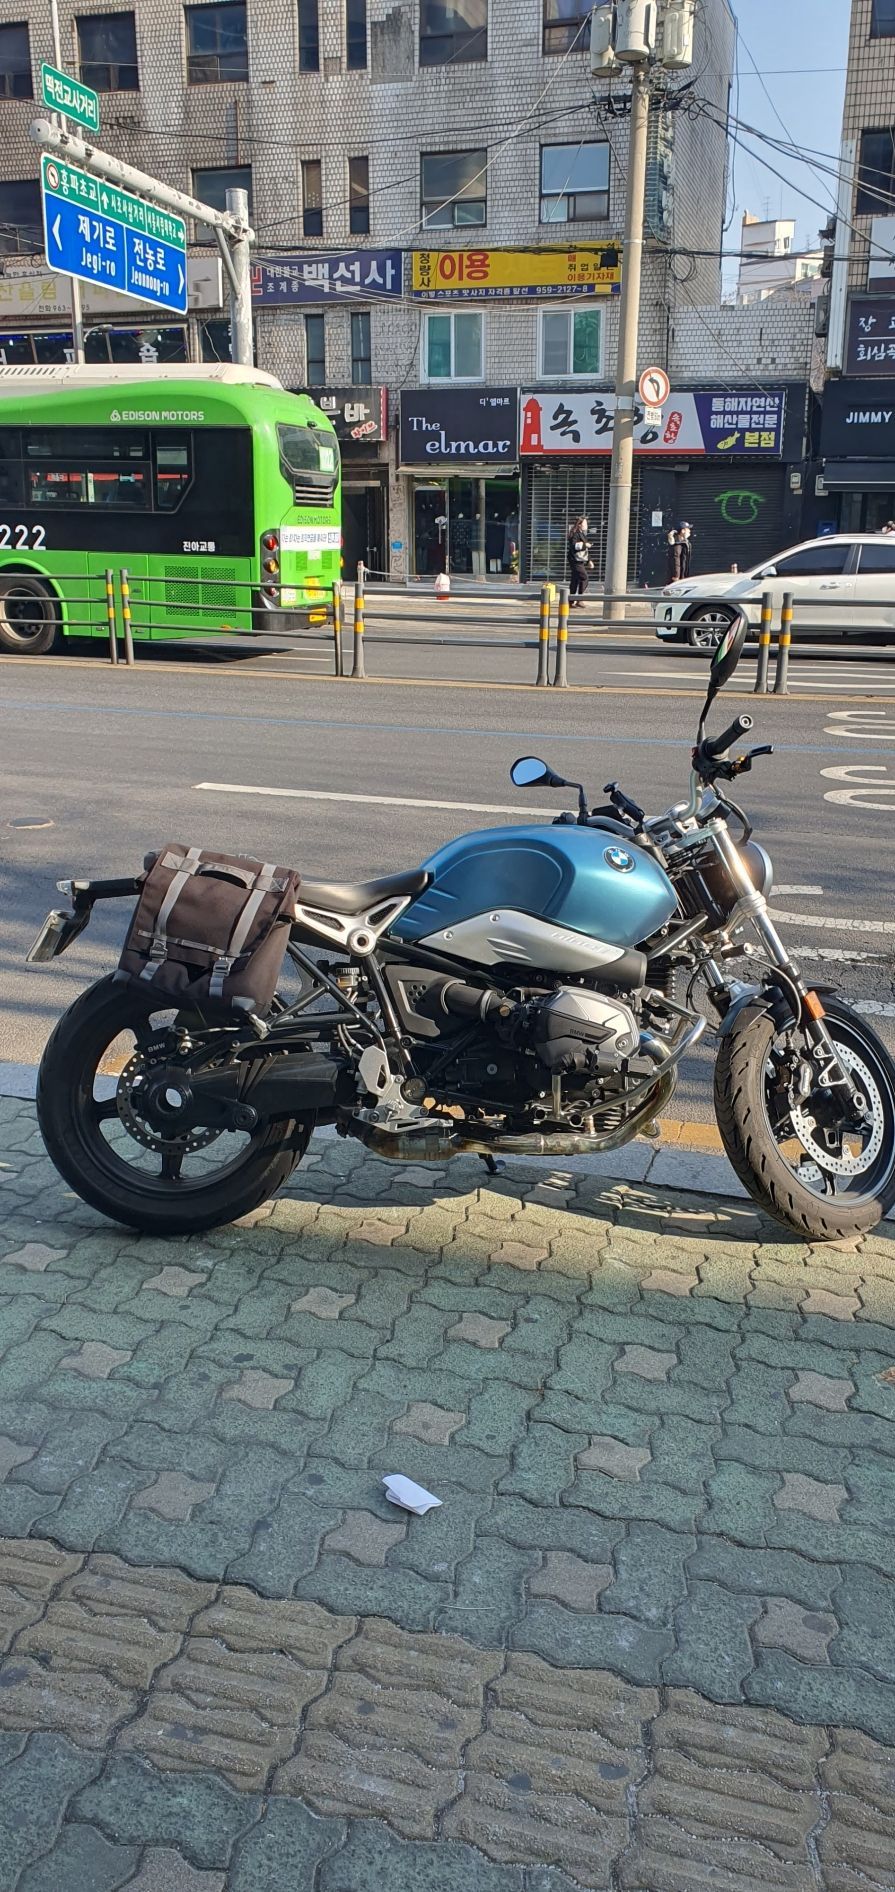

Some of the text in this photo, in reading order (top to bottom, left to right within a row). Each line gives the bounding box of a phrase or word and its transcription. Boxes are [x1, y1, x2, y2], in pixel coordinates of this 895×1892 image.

[60, 169, 97, 201] 홍파초교
[77, 214, 117, 251] 제기로
[81, 247, 116, 277] Jegi-ro
[133, 237, 166, 271] 전농로
[439, 252, 491, 281] 이용
[303, 259, 396, 293] 백선사
[122, 410, 205, 421] EDISON MOTORS
[711, 396, 780, 412] 동해자연산
[409, 417, 440, 431] The
[710, 414, 778, 429] 해산물전문
[846, 411, 893, 424] JIMMY
[425, 430, 510, 455] elmar
[744, 431, 776, 448] 본점
